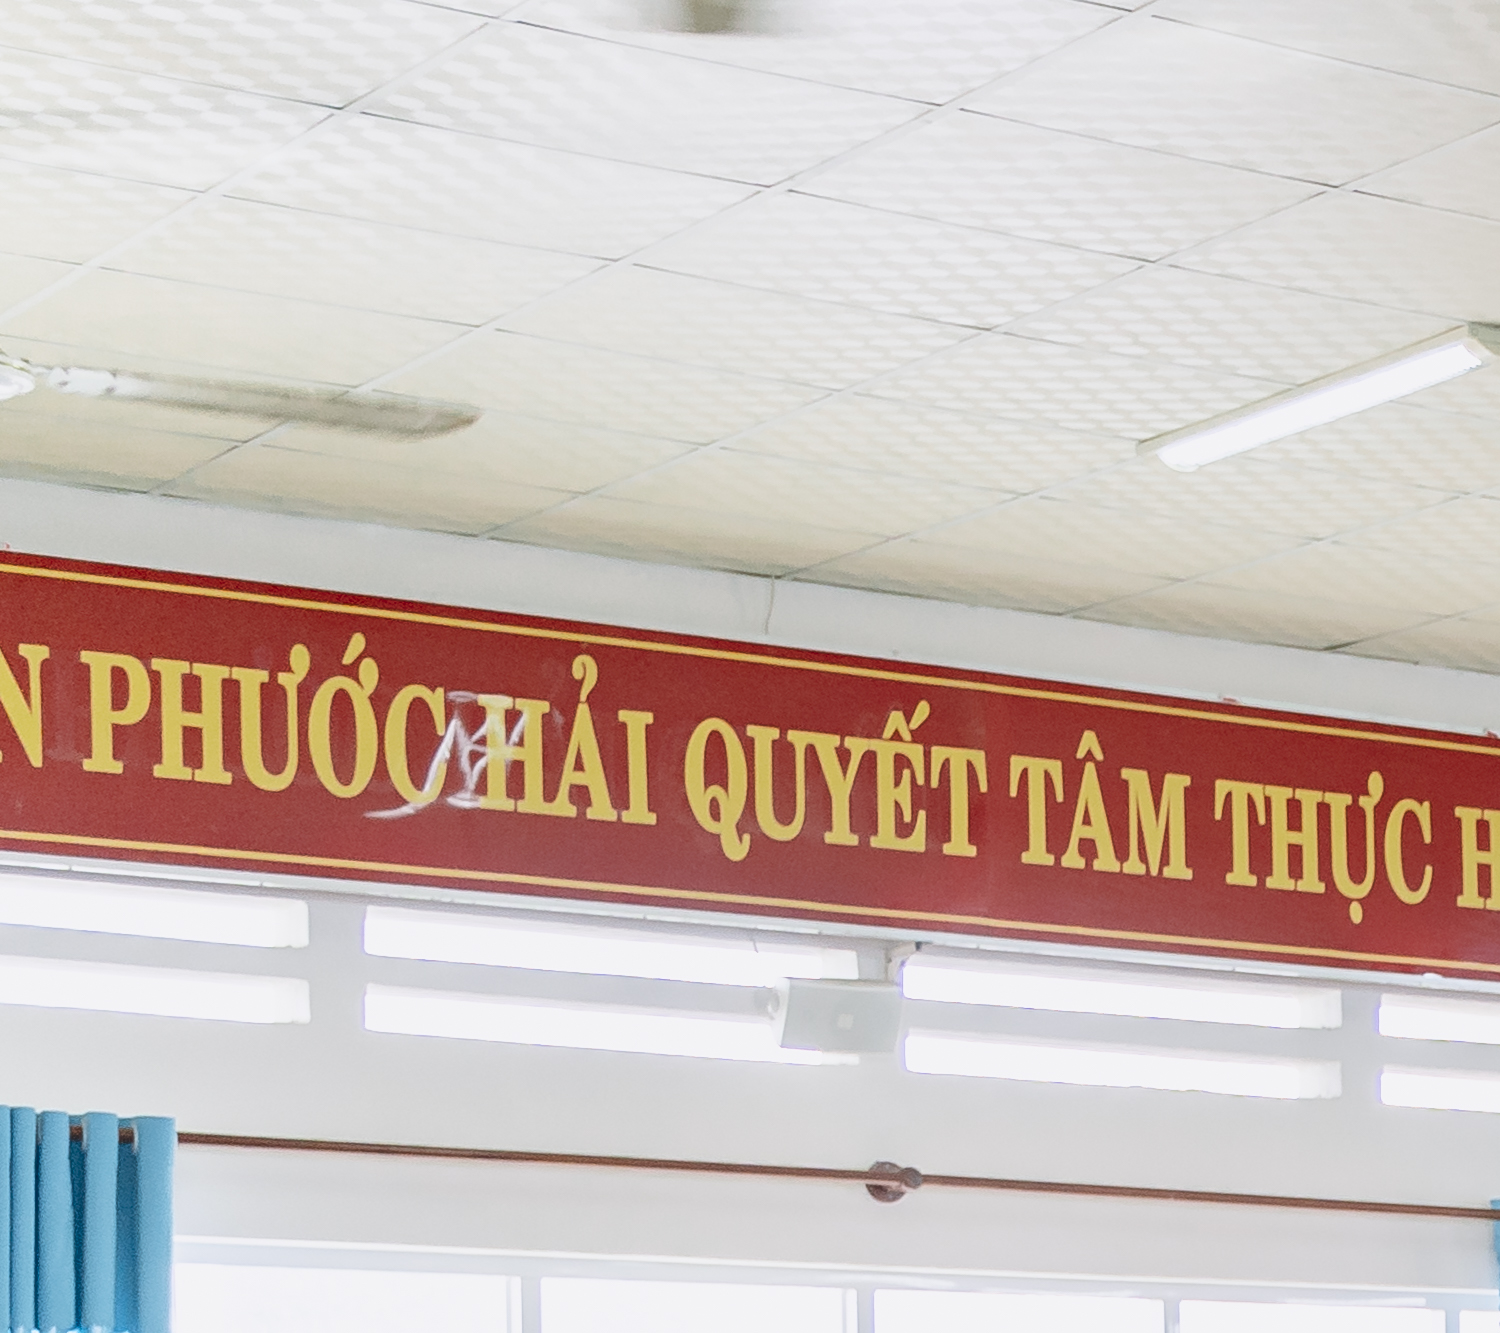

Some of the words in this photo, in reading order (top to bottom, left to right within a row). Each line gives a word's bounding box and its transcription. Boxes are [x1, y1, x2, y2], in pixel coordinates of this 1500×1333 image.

[80, 632, 447, 804] PHƯỚC
[476, 654, 657, 825] HẢI
[684, 700, 988, 862] QUYẾT
[1010, 731, 1193, 880] TÂM
[1215, 771, 1433, 925] THỰC
